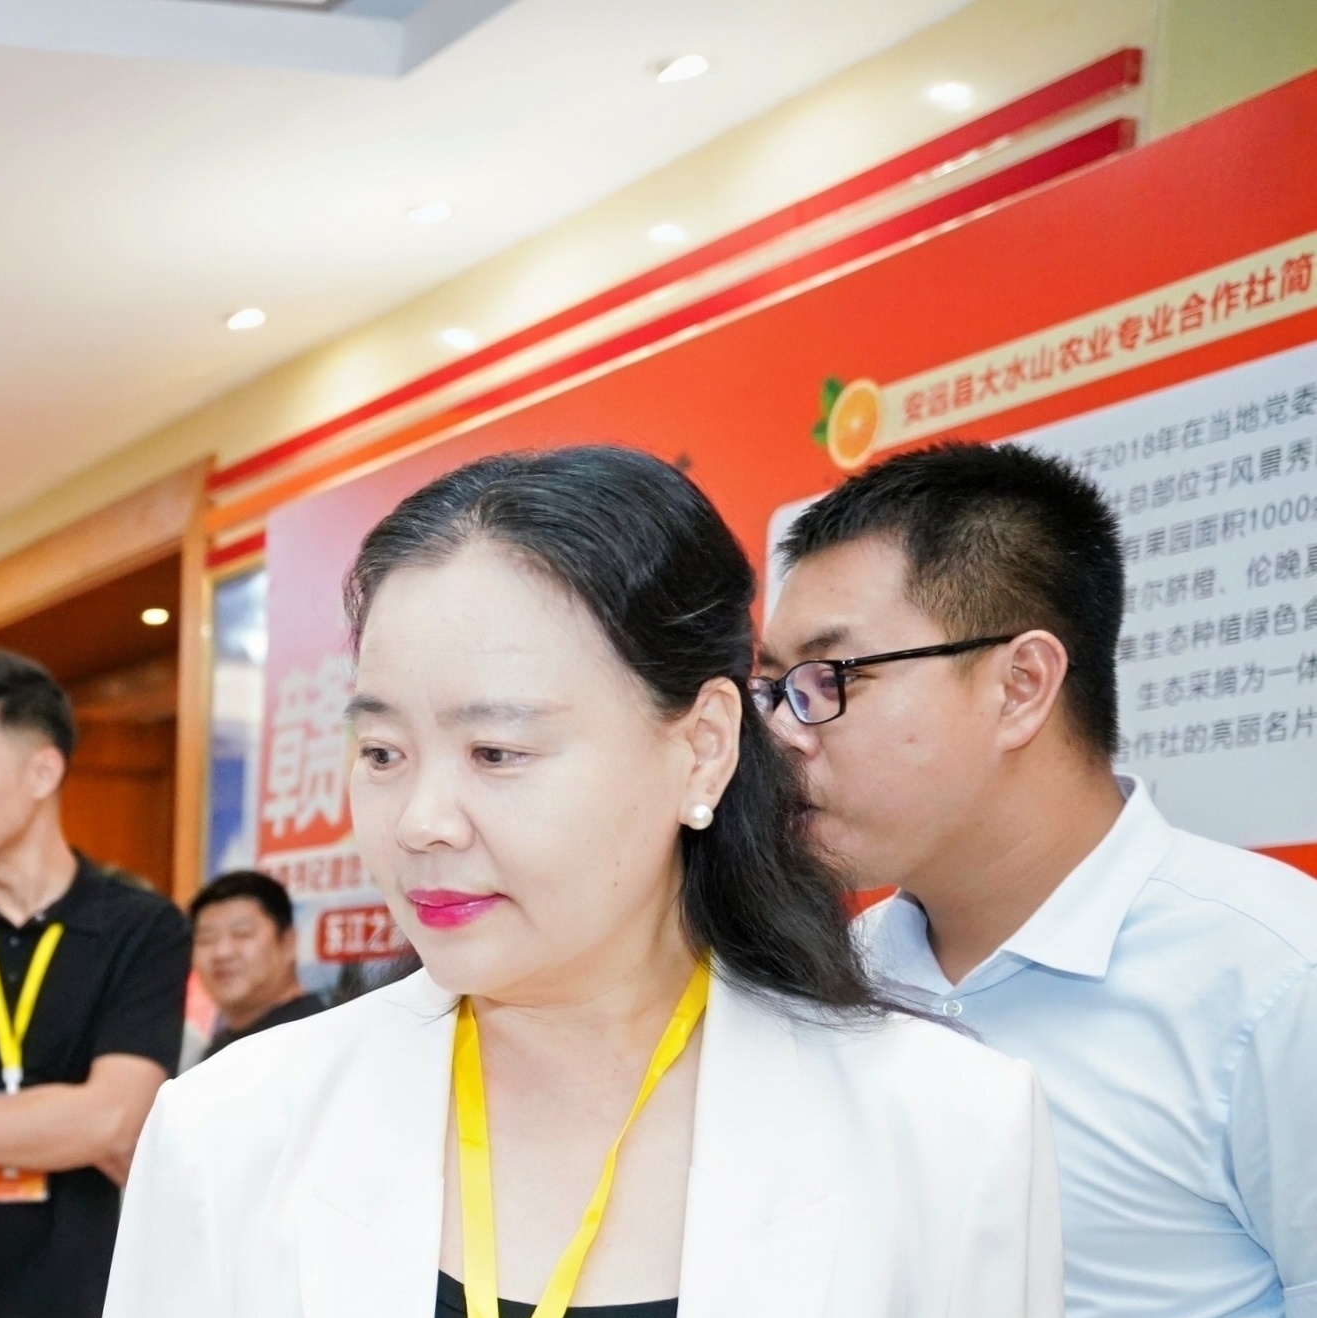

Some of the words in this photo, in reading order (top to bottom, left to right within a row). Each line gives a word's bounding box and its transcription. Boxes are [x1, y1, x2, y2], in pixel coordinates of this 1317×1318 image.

[1110, 436, 1317, 515] 总部位于风景秀
